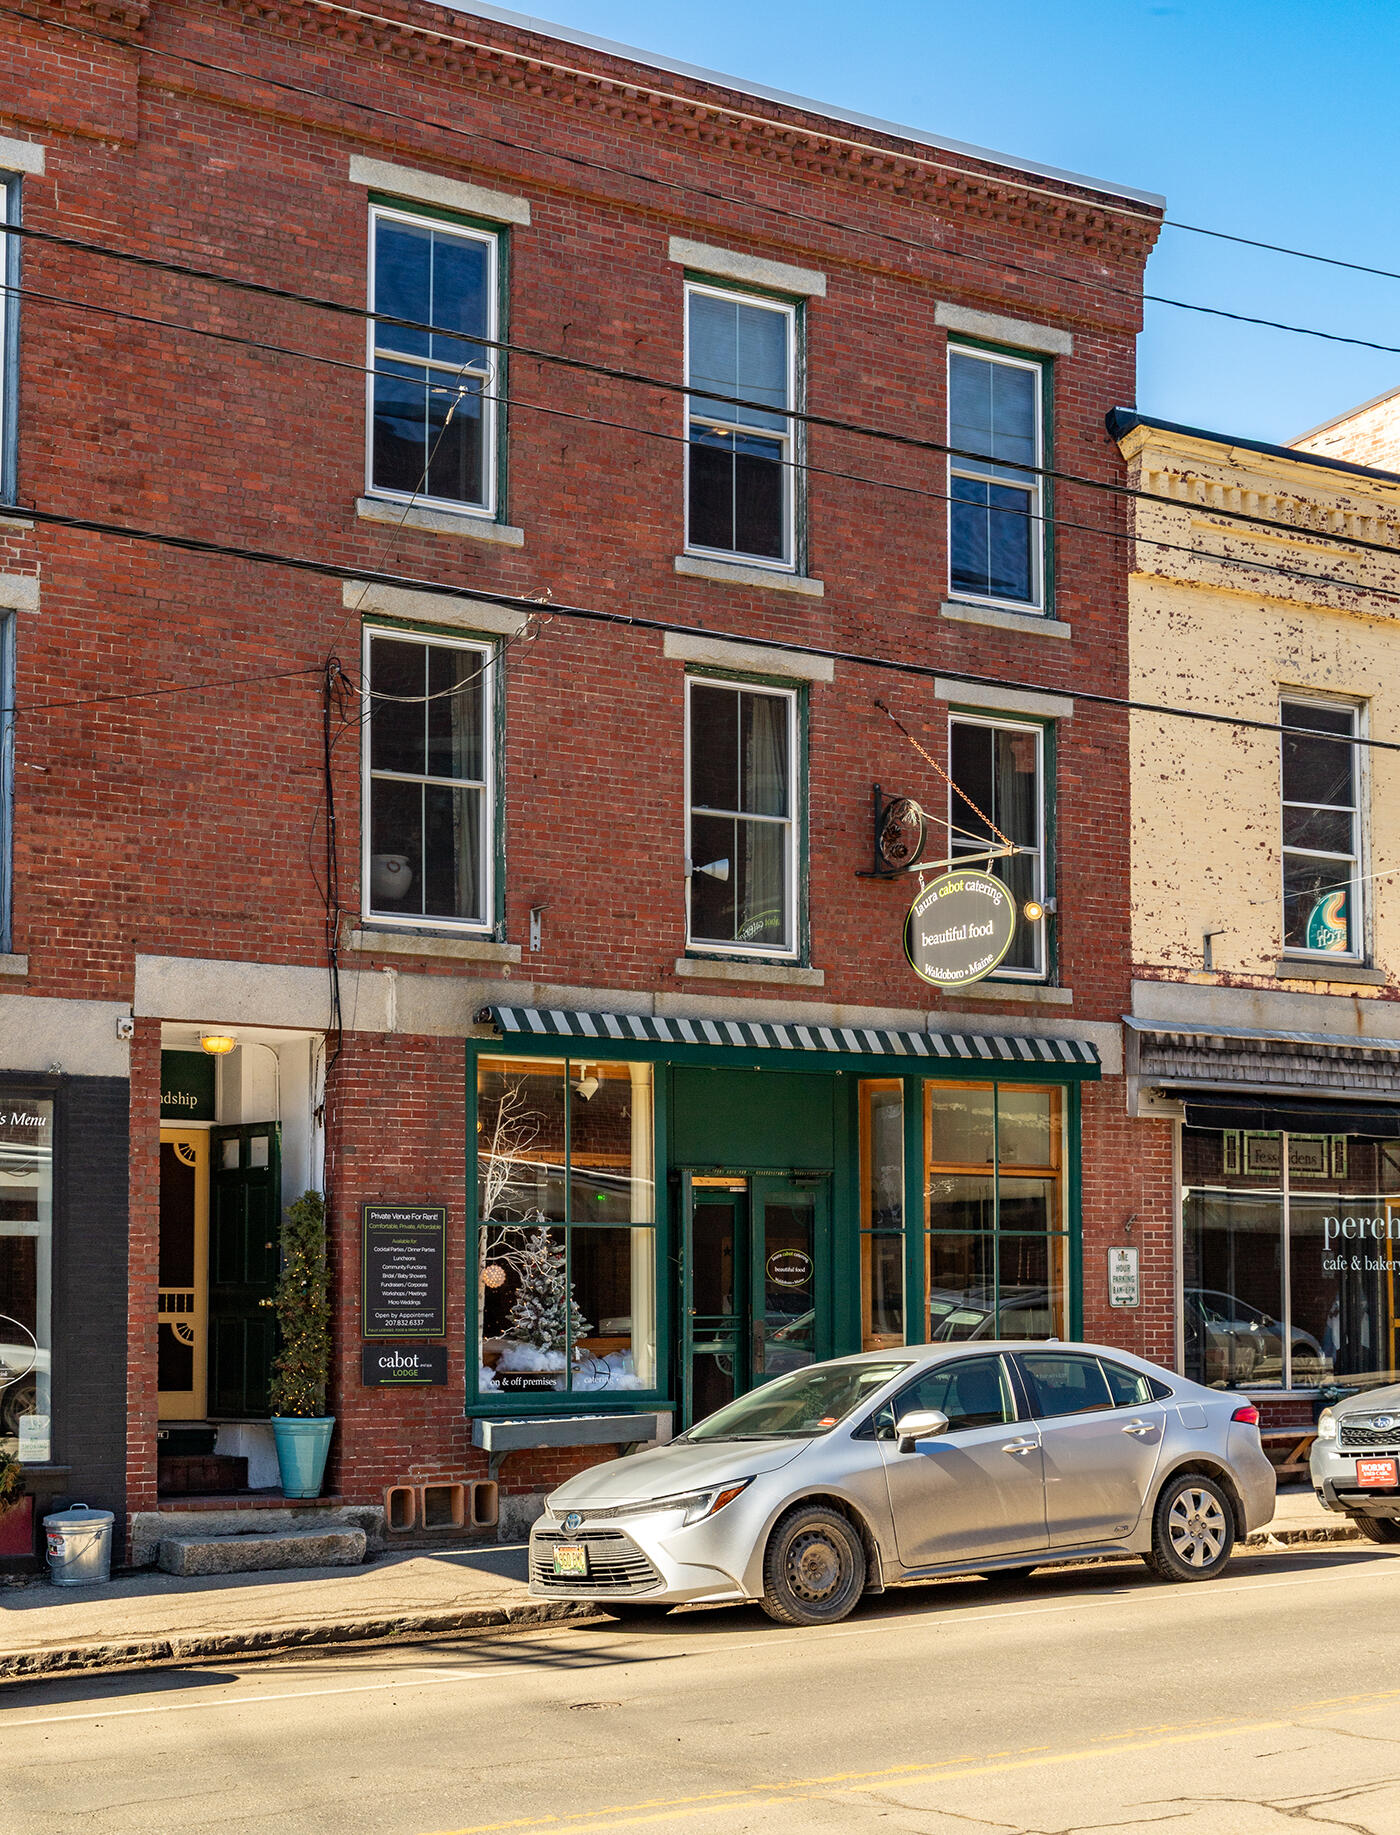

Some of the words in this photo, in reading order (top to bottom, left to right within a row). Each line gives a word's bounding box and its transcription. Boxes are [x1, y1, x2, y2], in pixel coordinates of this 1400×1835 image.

[914, 892, 938, 917] laura
[938, 880, 964, 898] cabot
[965, 880, 1003, 906] catering
[921, 925, 968, 947] beautiful
[968, 920, 994, 939] food
[924, 963, 965, 980] Waldoboro
[968, 953, 994, 975] Maine
[10, 1112, 47, 1126] Menu
[370, 1212, 392, 1220] Private
[1323, 1254, 1348, 1271] cafe
[1350, 1255, 1361, 1271] &
[1112, 1275, 1135, 1283] PARKING
[378, 1351, 420, 1368] cabot
[489, 1379, 500, 1387] on
[502, 1377, 510, 1386] &
[511, 1376, 522, 1386] off
[523, 1377, 557, 1388] premises
